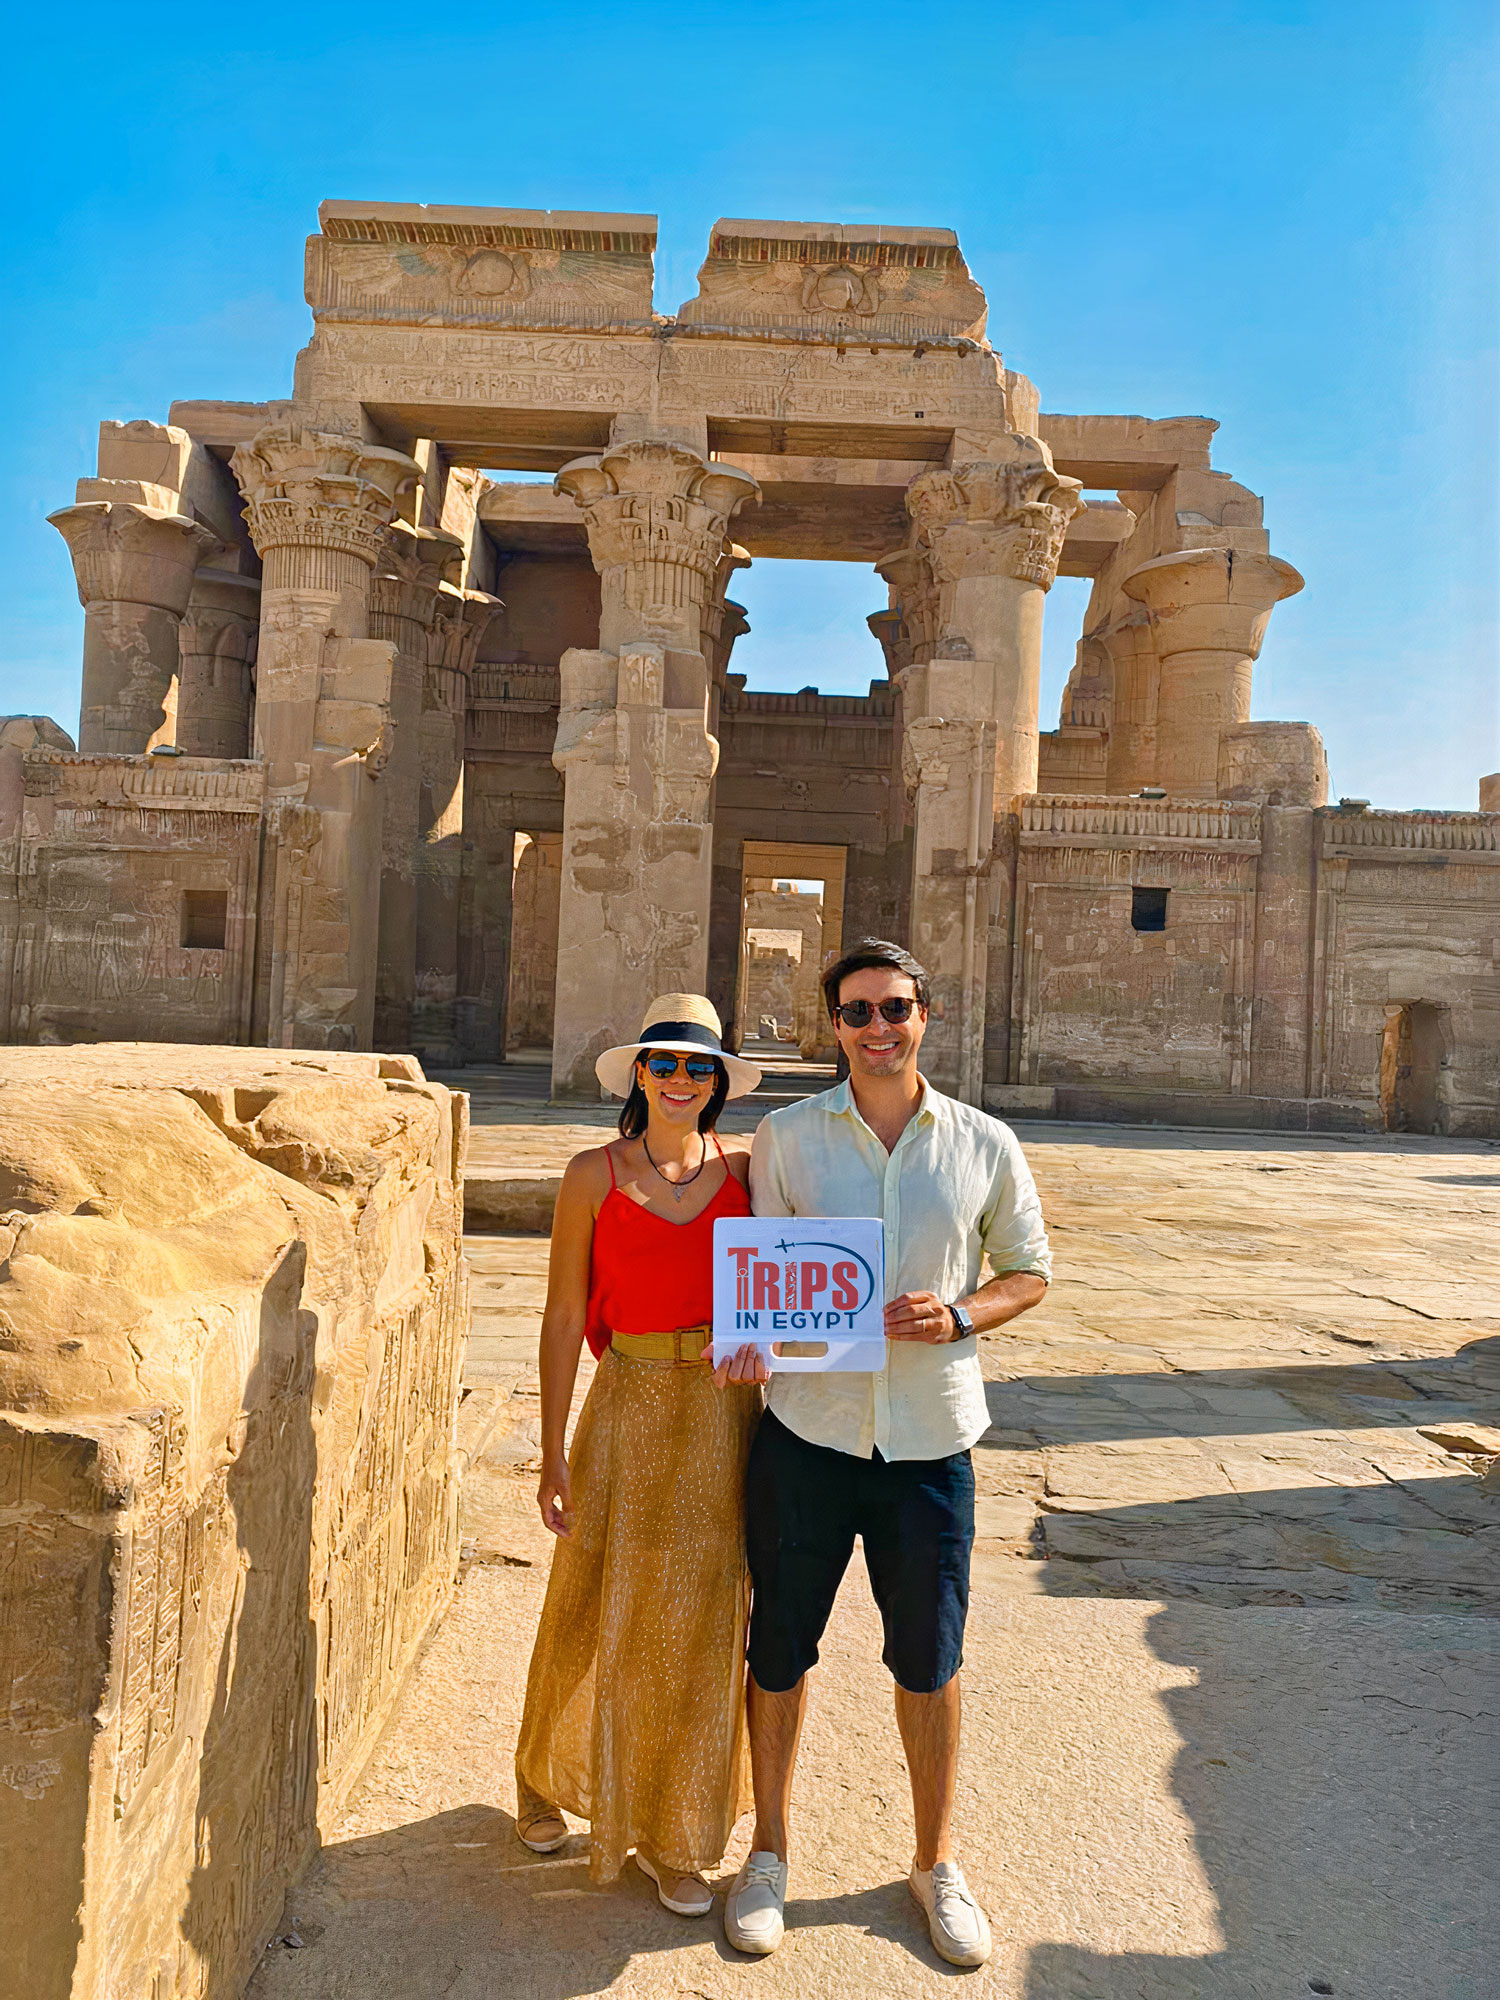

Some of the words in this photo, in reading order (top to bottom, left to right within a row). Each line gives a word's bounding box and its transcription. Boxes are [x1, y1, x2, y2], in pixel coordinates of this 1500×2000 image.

[728, 1247, 859, 1310] TRIPS
[736, 1312, 759, 1329] IN
[773, 1312, 857, 1329] EGYPT
